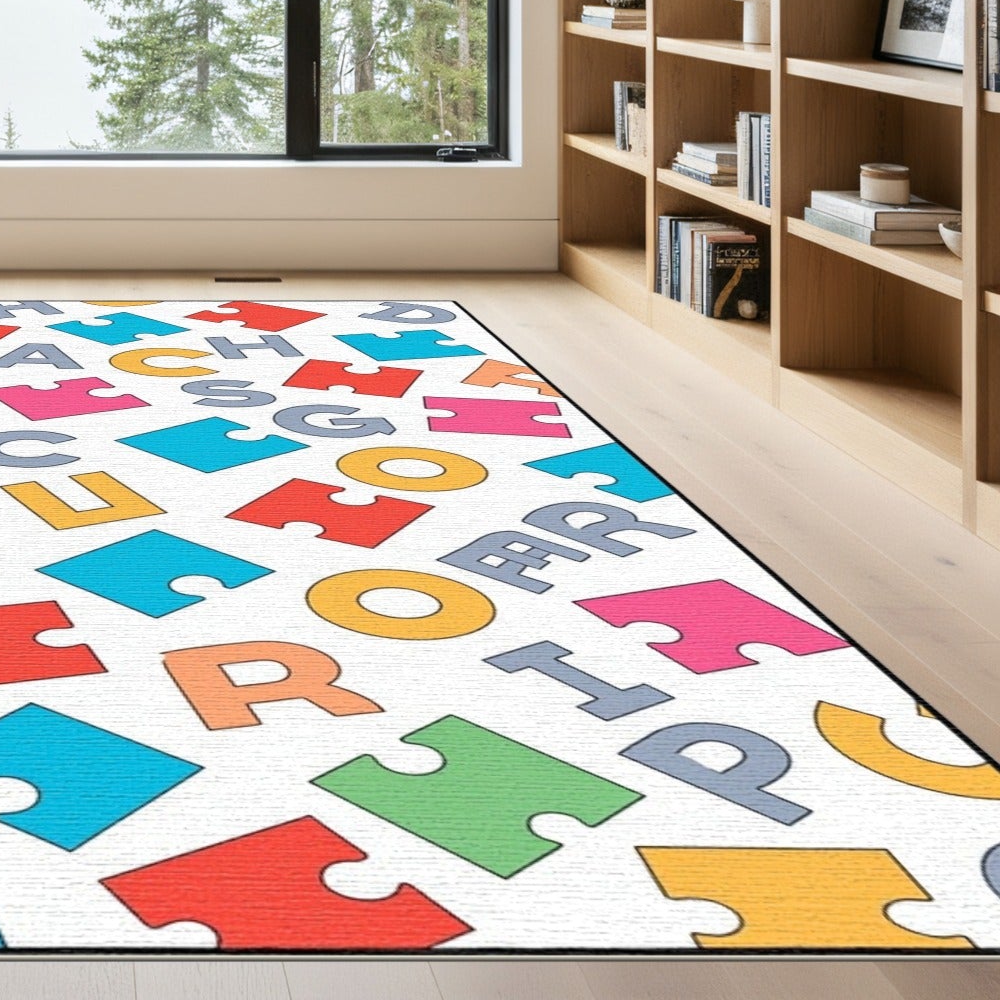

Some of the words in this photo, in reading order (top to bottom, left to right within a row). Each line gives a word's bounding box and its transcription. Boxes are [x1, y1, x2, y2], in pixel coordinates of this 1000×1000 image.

[109, 348, 219, 378] C
[205, 334, 305, 360] H
[181, 379, 277, 408] S
[272, 404, 397, 439] G
[335, 446, 489, 493] O
[521, 501, 698, 558] R
[305, 568, 498, 641] O
[161, 640, 386, 732] R
[482, 640, 676, 722] I
[617, 722, 814, 827] P
